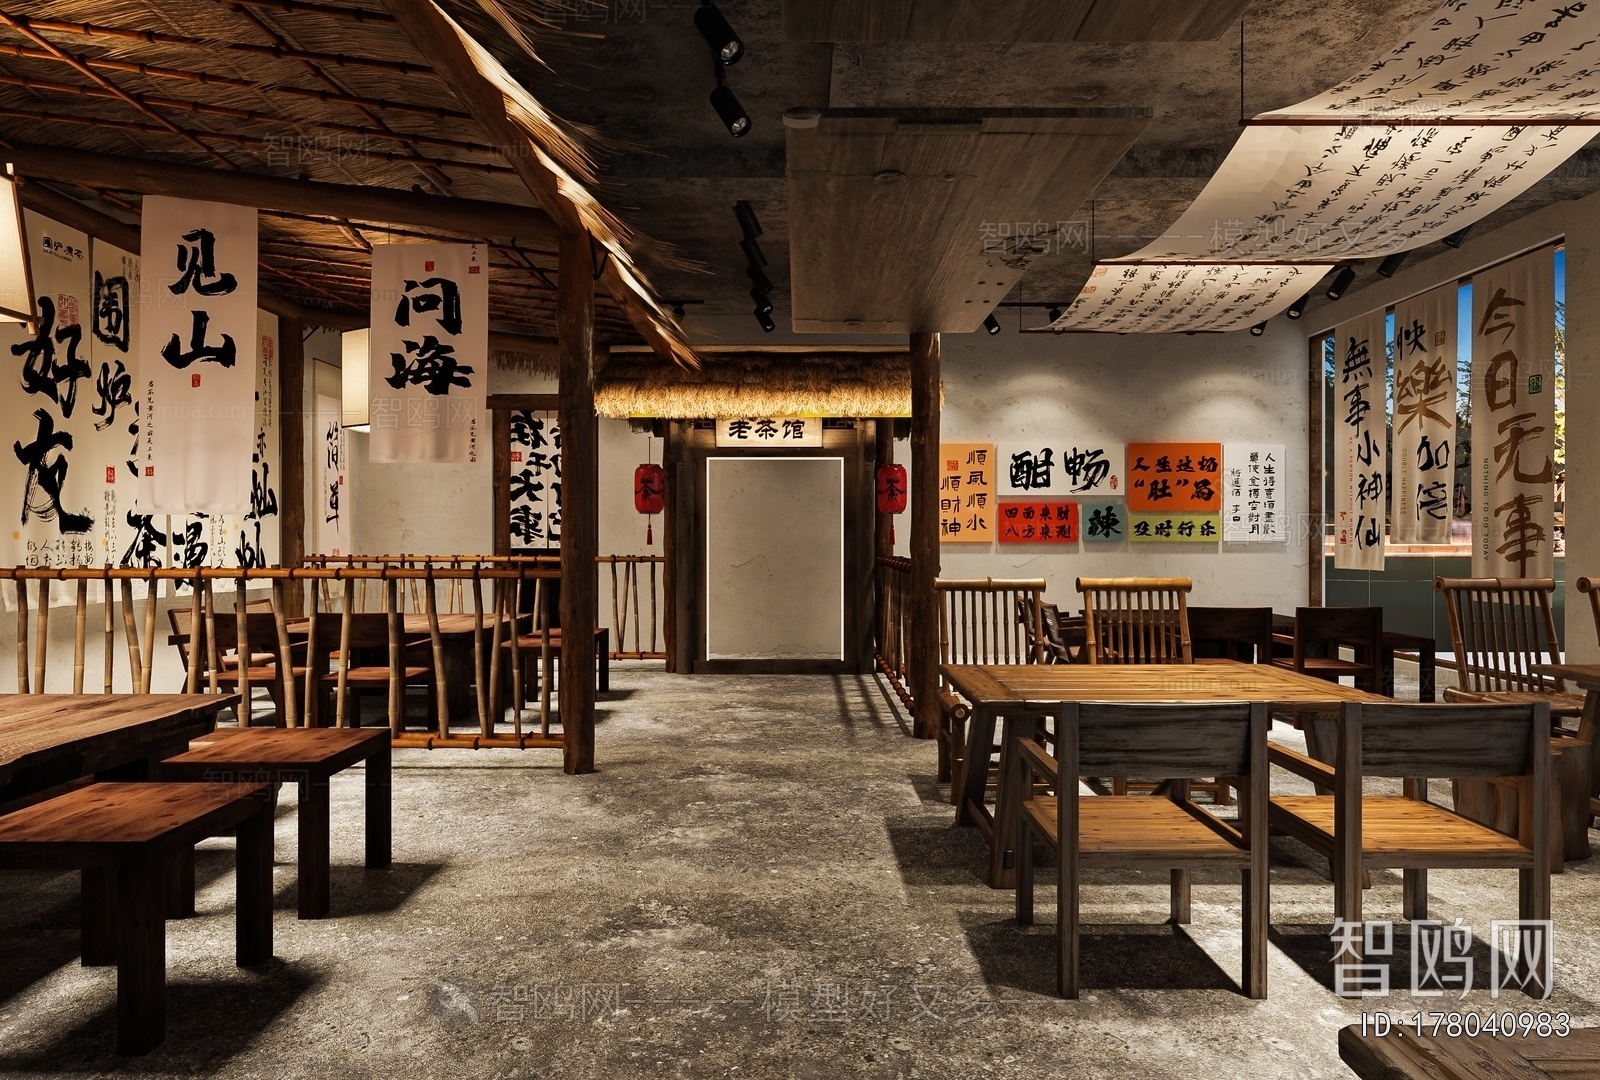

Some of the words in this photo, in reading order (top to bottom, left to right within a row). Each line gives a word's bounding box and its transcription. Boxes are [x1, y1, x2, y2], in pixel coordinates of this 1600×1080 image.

[160, 227, 238, 370] 见山
[92, 268, 133, 432] 围炉
[384, 277, 475, 395] 问海
[11, 296, 95, 535] 好友
[728, 418, 806, 441] 老茶馆
[1477, 287, 1554, 578] 今日无事
[966, 449, 988, 531] 順風順水
[1009, 446, 1110, 494] 酣畅
[1131, 455, 1219, 473] 人生这场
[940, 475, 961, 537] 順財神
[1133, 519, 1217, 537] 及时行乐
[1483, 502, 1489, 512] TO
[1483, 516, 1489, 528] DO
